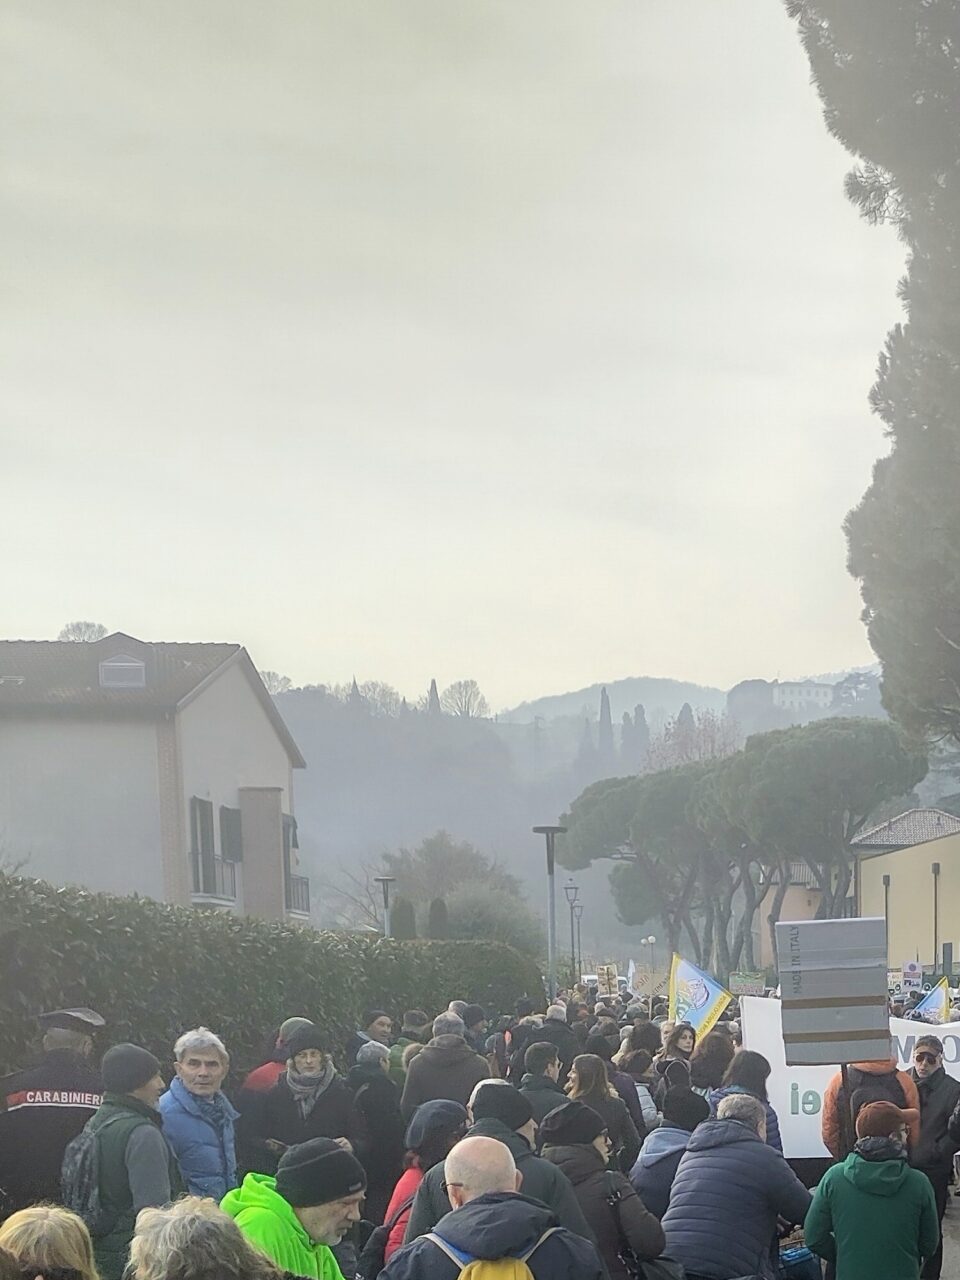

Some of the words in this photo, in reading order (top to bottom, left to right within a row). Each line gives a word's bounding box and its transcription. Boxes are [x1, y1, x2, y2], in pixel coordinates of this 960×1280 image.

[789, 925, 800, 952] ITALY
[791, 955, 801, 966] IN
[791, 970, 802, 995] MADE
